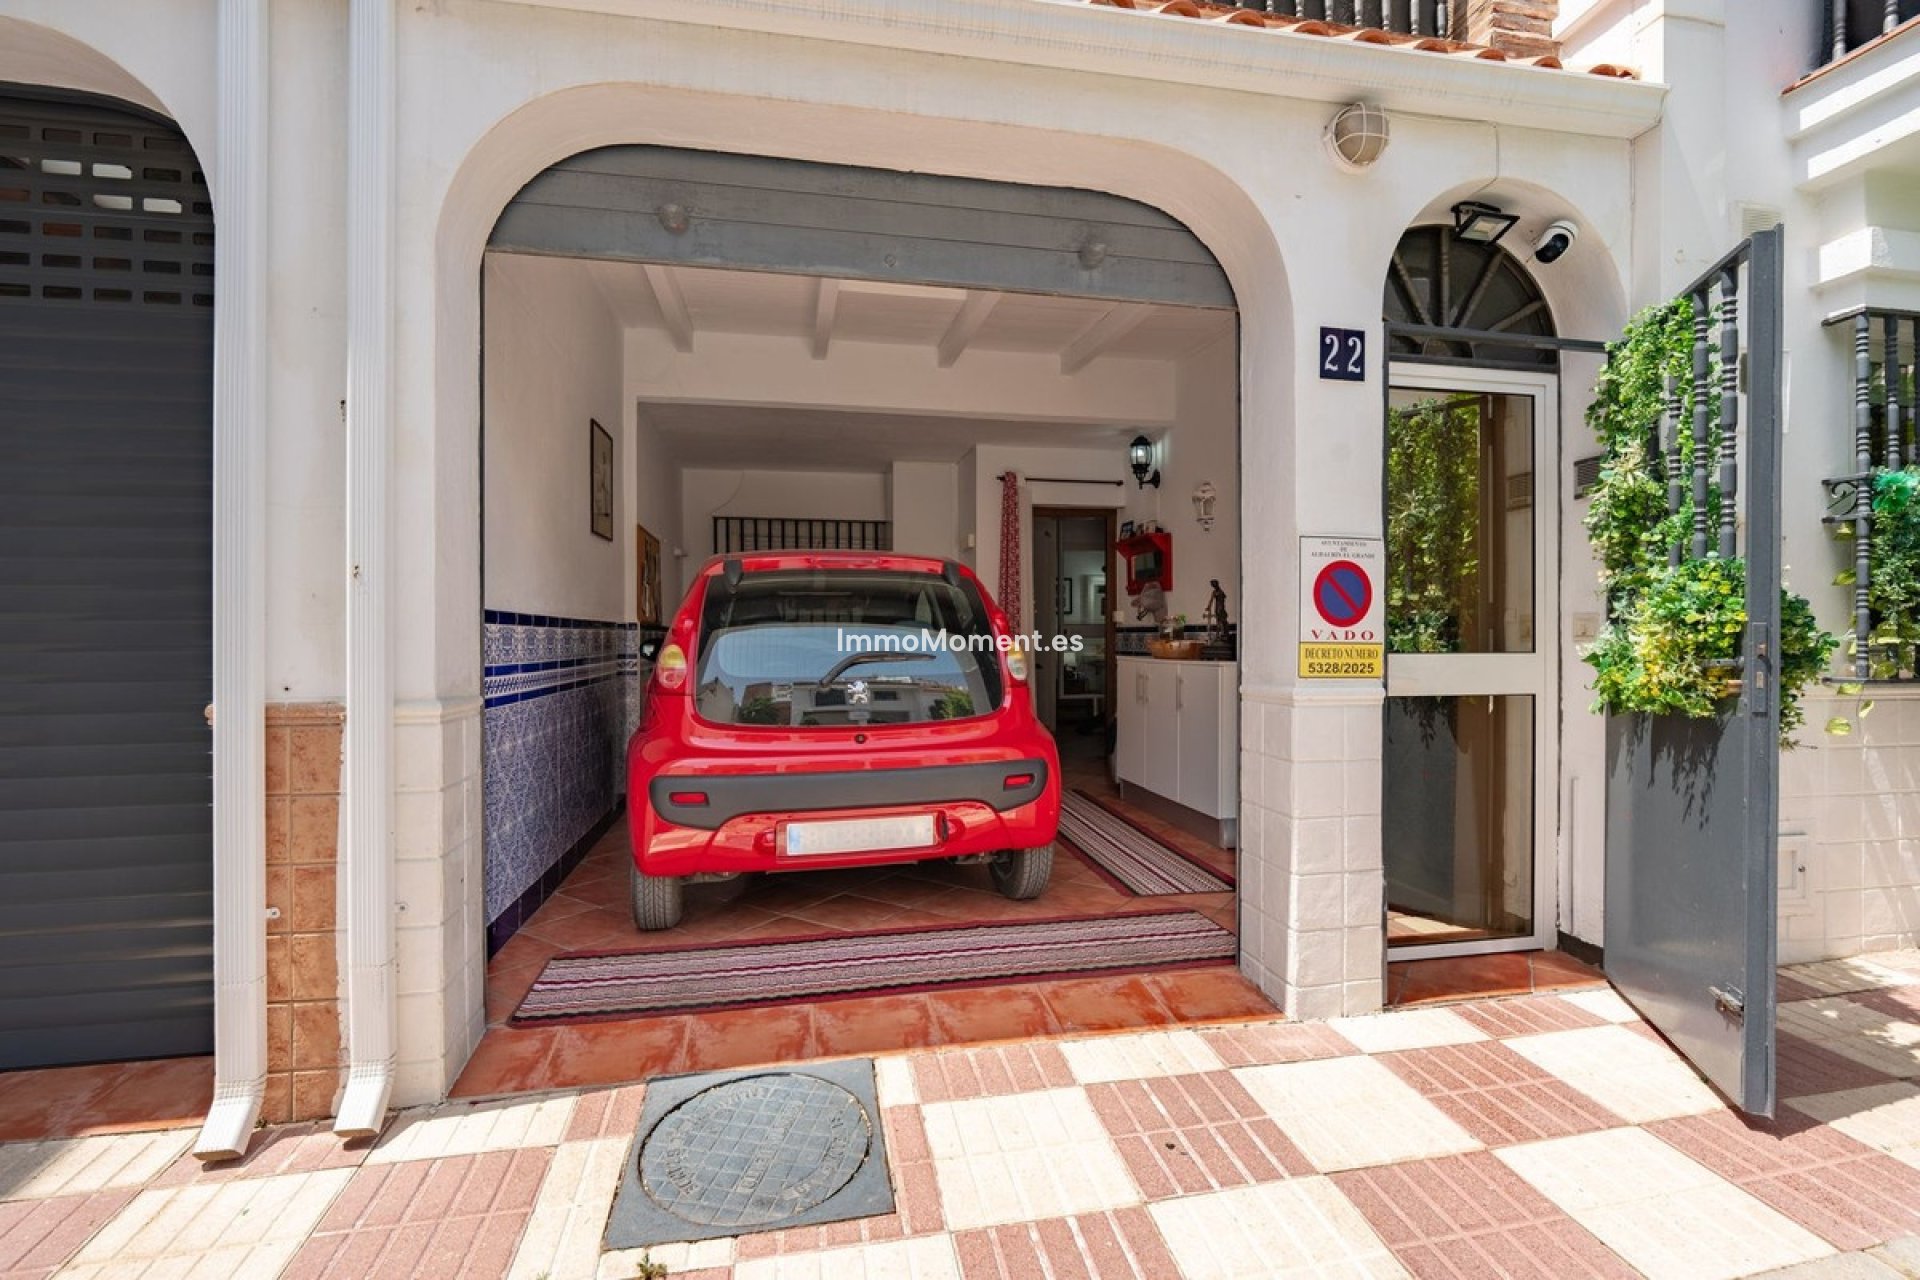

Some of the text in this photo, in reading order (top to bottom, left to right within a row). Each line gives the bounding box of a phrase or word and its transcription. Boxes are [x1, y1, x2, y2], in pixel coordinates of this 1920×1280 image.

[1324, 334, 1362, 373] 22
[1311, 629, 1374, 641] VADO
[1305, 647, 1343, 660] DECRETO
[1308, 661, 1375, 674] 5328/2025
